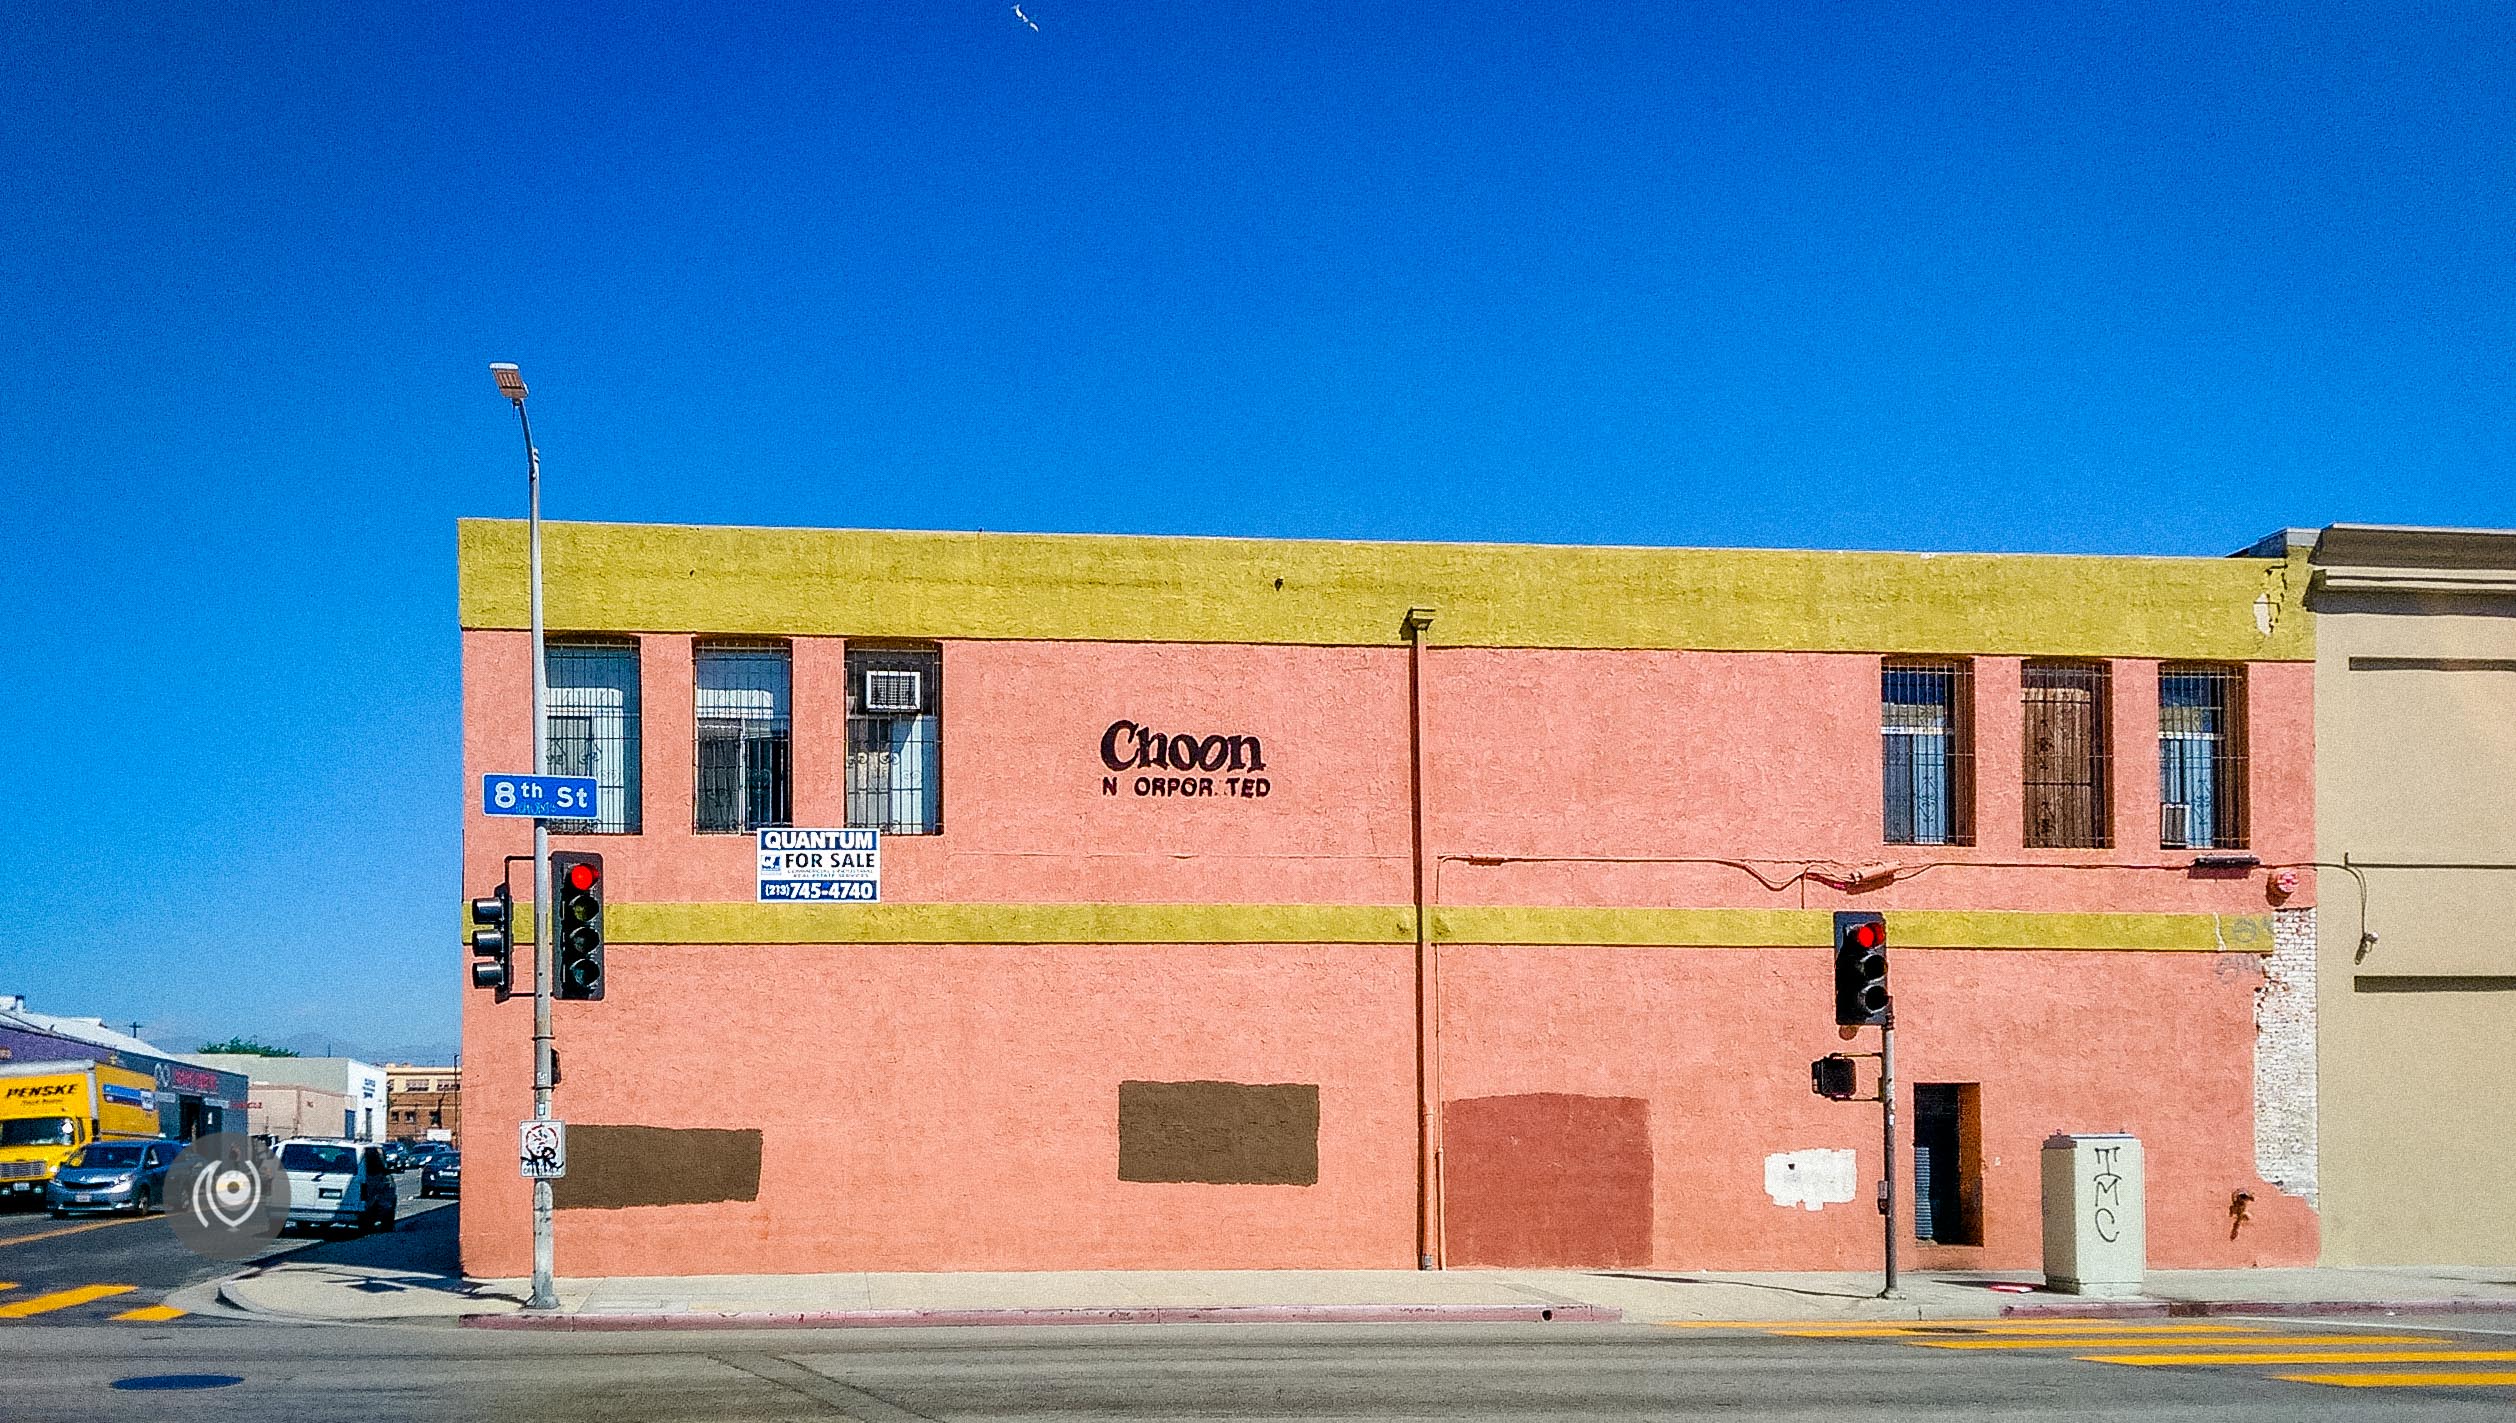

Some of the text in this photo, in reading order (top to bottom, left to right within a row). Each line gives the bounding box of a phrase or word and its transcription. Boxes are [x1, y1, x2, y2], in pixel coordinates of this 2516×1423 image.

[1100, 719, 1267, 774] Choon
[494, 781, 543, 809] 8th
[556, 786, 588, 808] St
[764, 831, 873, 850] QUANTUM
[785, 853, 875, 868] FOR SALE
[6, 1083, 79, 1098] PENSKE
